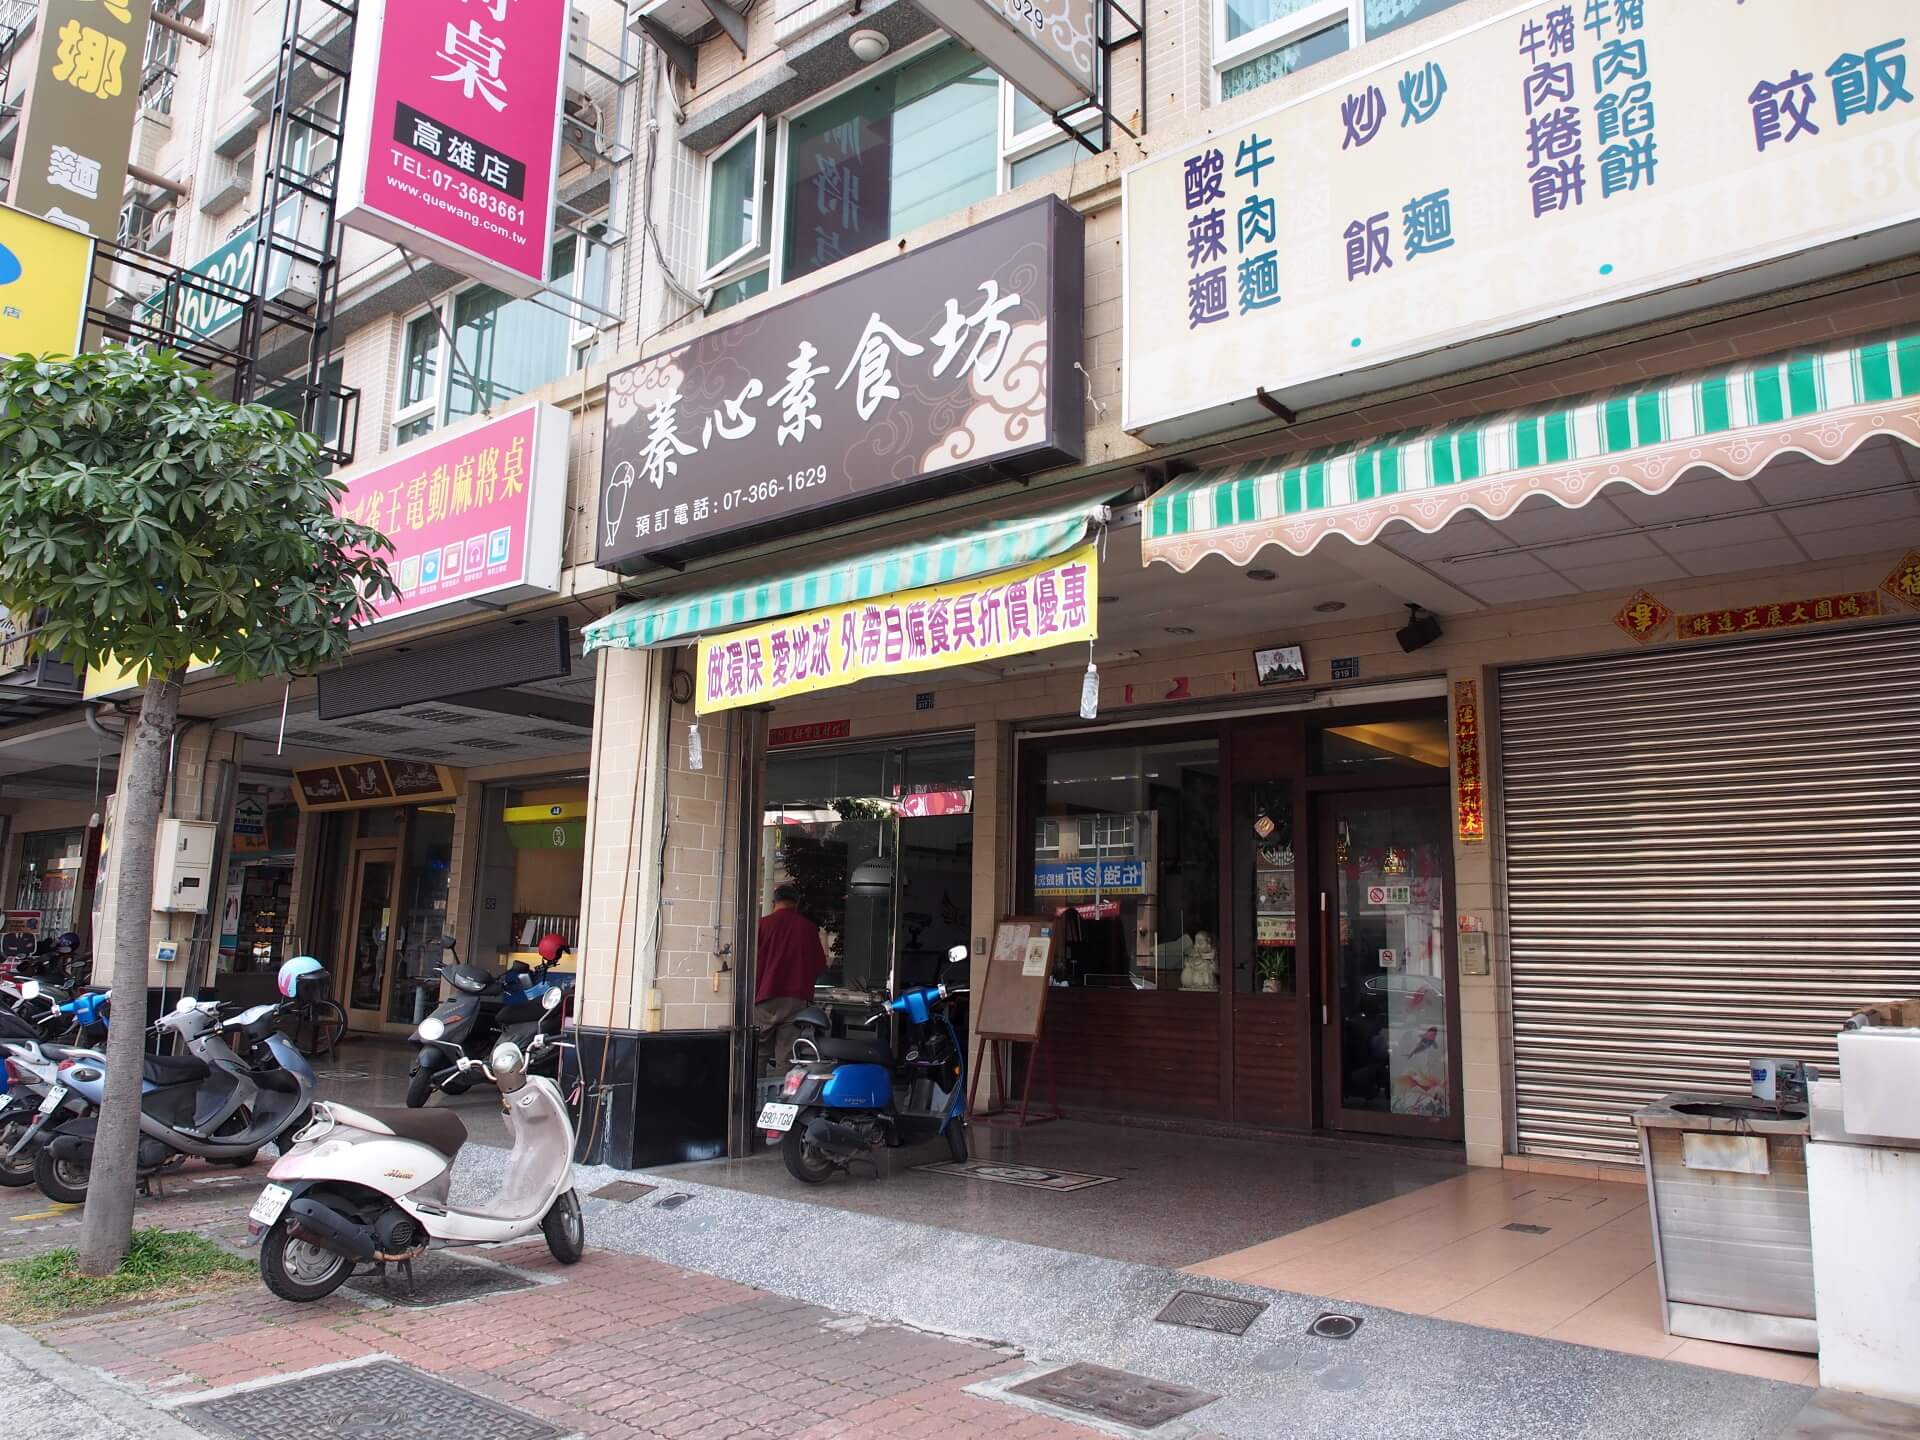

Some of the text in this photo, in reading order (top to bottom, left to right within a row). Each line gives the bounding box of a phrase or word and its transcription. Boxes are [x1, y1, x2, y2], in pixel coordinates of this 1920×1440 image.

[52, 0, 132, 99] 娜
[412, 117, 510, 190] 高雄店
[386, 174, 527, 246] www.quewang.com.tw
[1184, 148, 1230, 330] 酸辣麵
[1234, 133, 1281, 316] 牛肉麵
[770, 617, 831, 689] 愛地球
